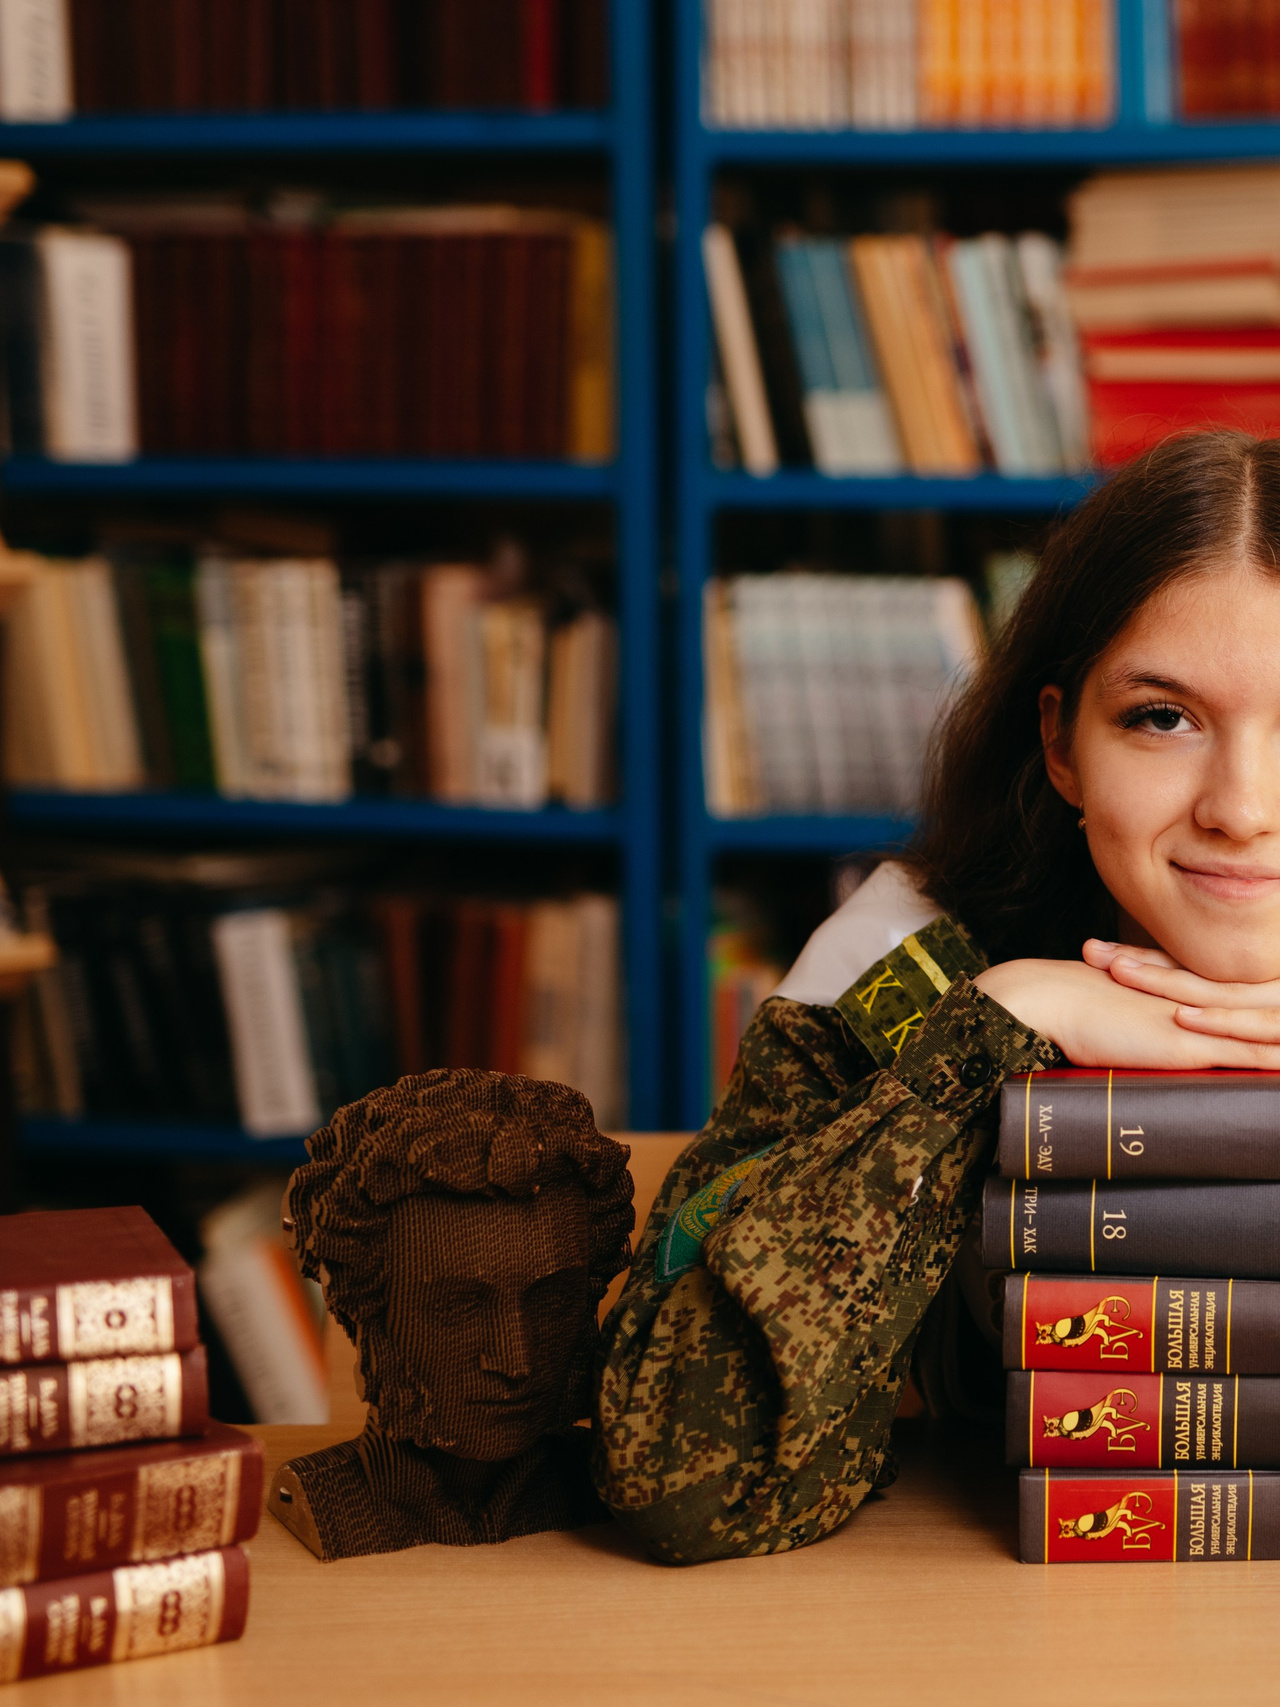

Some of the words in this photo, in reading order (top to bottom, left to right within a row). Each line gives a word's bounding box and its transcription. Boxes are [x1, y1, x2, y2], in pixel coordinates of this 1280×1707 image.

[1119, 1125, 1145, 1156] 19
[1102, 1209, 1127, 1240] 18
[1167, 1289, 1184, 1369] БОЛЬШАЯ
[1188, 1291, 1200, 1369] УНИВЕРСАЛЬНАЯ
[1204, 1291, 1217, 1370] ЭНЦИКЛОПЕДИЯ
[1174, 1381, 1191, 1461] БОЛЬШАЯ
[1196, 1383, 1207, 1461] УНИВЕРСАЛЬНАЯ
[1211, 1383, 1224, 1461] ЭНЦИКЛОПЕДИЯ
[1189, 1483, 1206, 1556] БОЛЬШАЯ
[1210, 1484, 1221, 1556] УНИВЕРСАЛЬНАЯ
[1226, 1483, 1238, 1556] ЭНЦИКЛОПЕДИЯ
